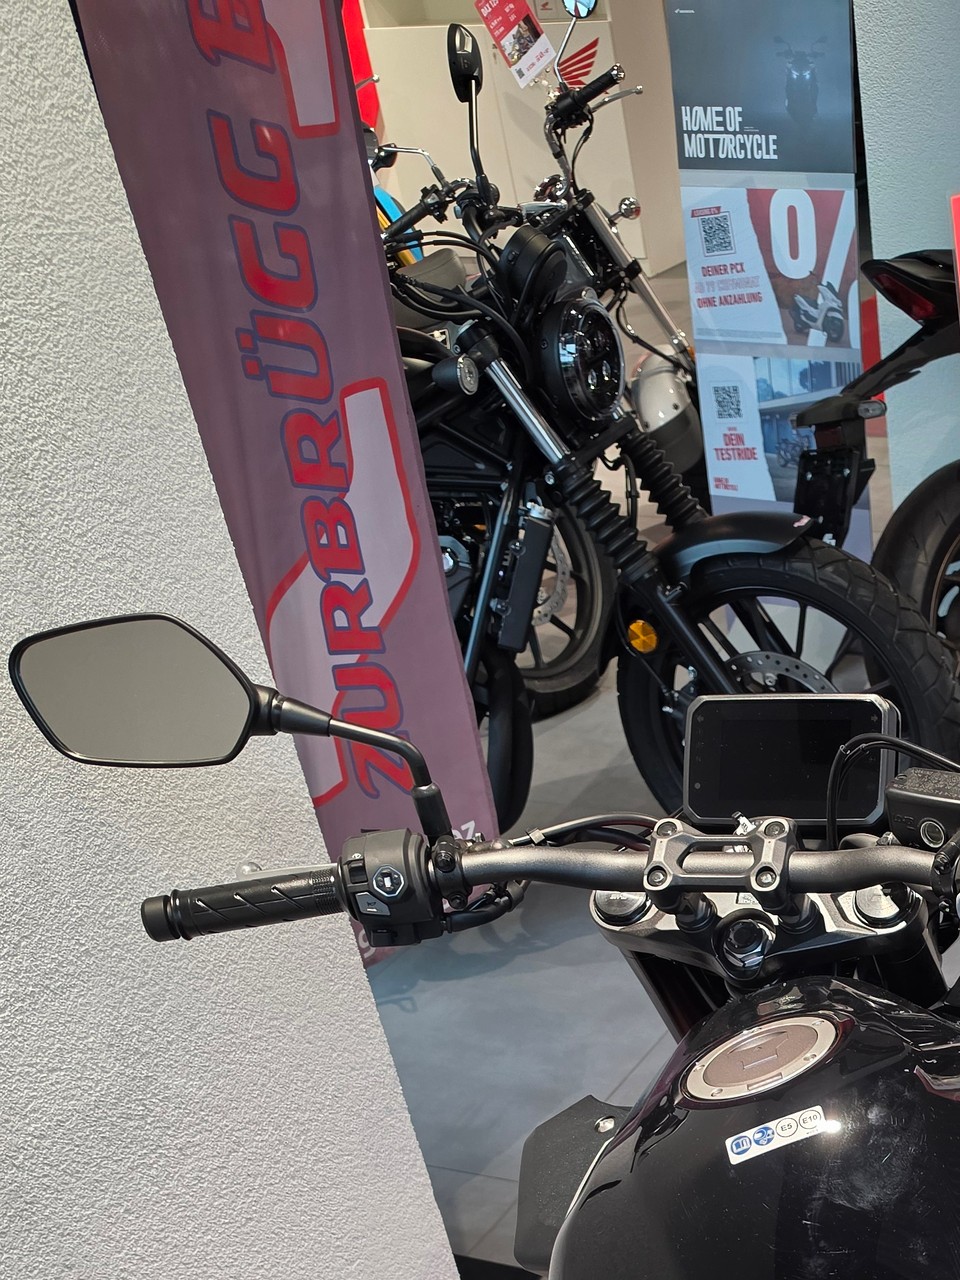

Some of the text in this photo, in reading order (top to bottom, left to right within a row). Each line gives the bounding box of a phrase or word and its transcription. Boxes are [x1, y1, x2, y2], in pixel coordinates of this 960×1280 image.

[681, 106, 743, 132] HOME OF
[683, 133, 779, 160] MOTORCYCLE
[701, 262, 746, 278] DEINER PCX
[697, 292, 763, 309] OHNE ANZAHLUNG
[723, 433, 745, 447] DEIN
[207, 108, 413, 799] ZURBRÜGG
[714, 447, 758, 461] TESTRIDE
[781, 1114, 818, 1132] E5 E10
